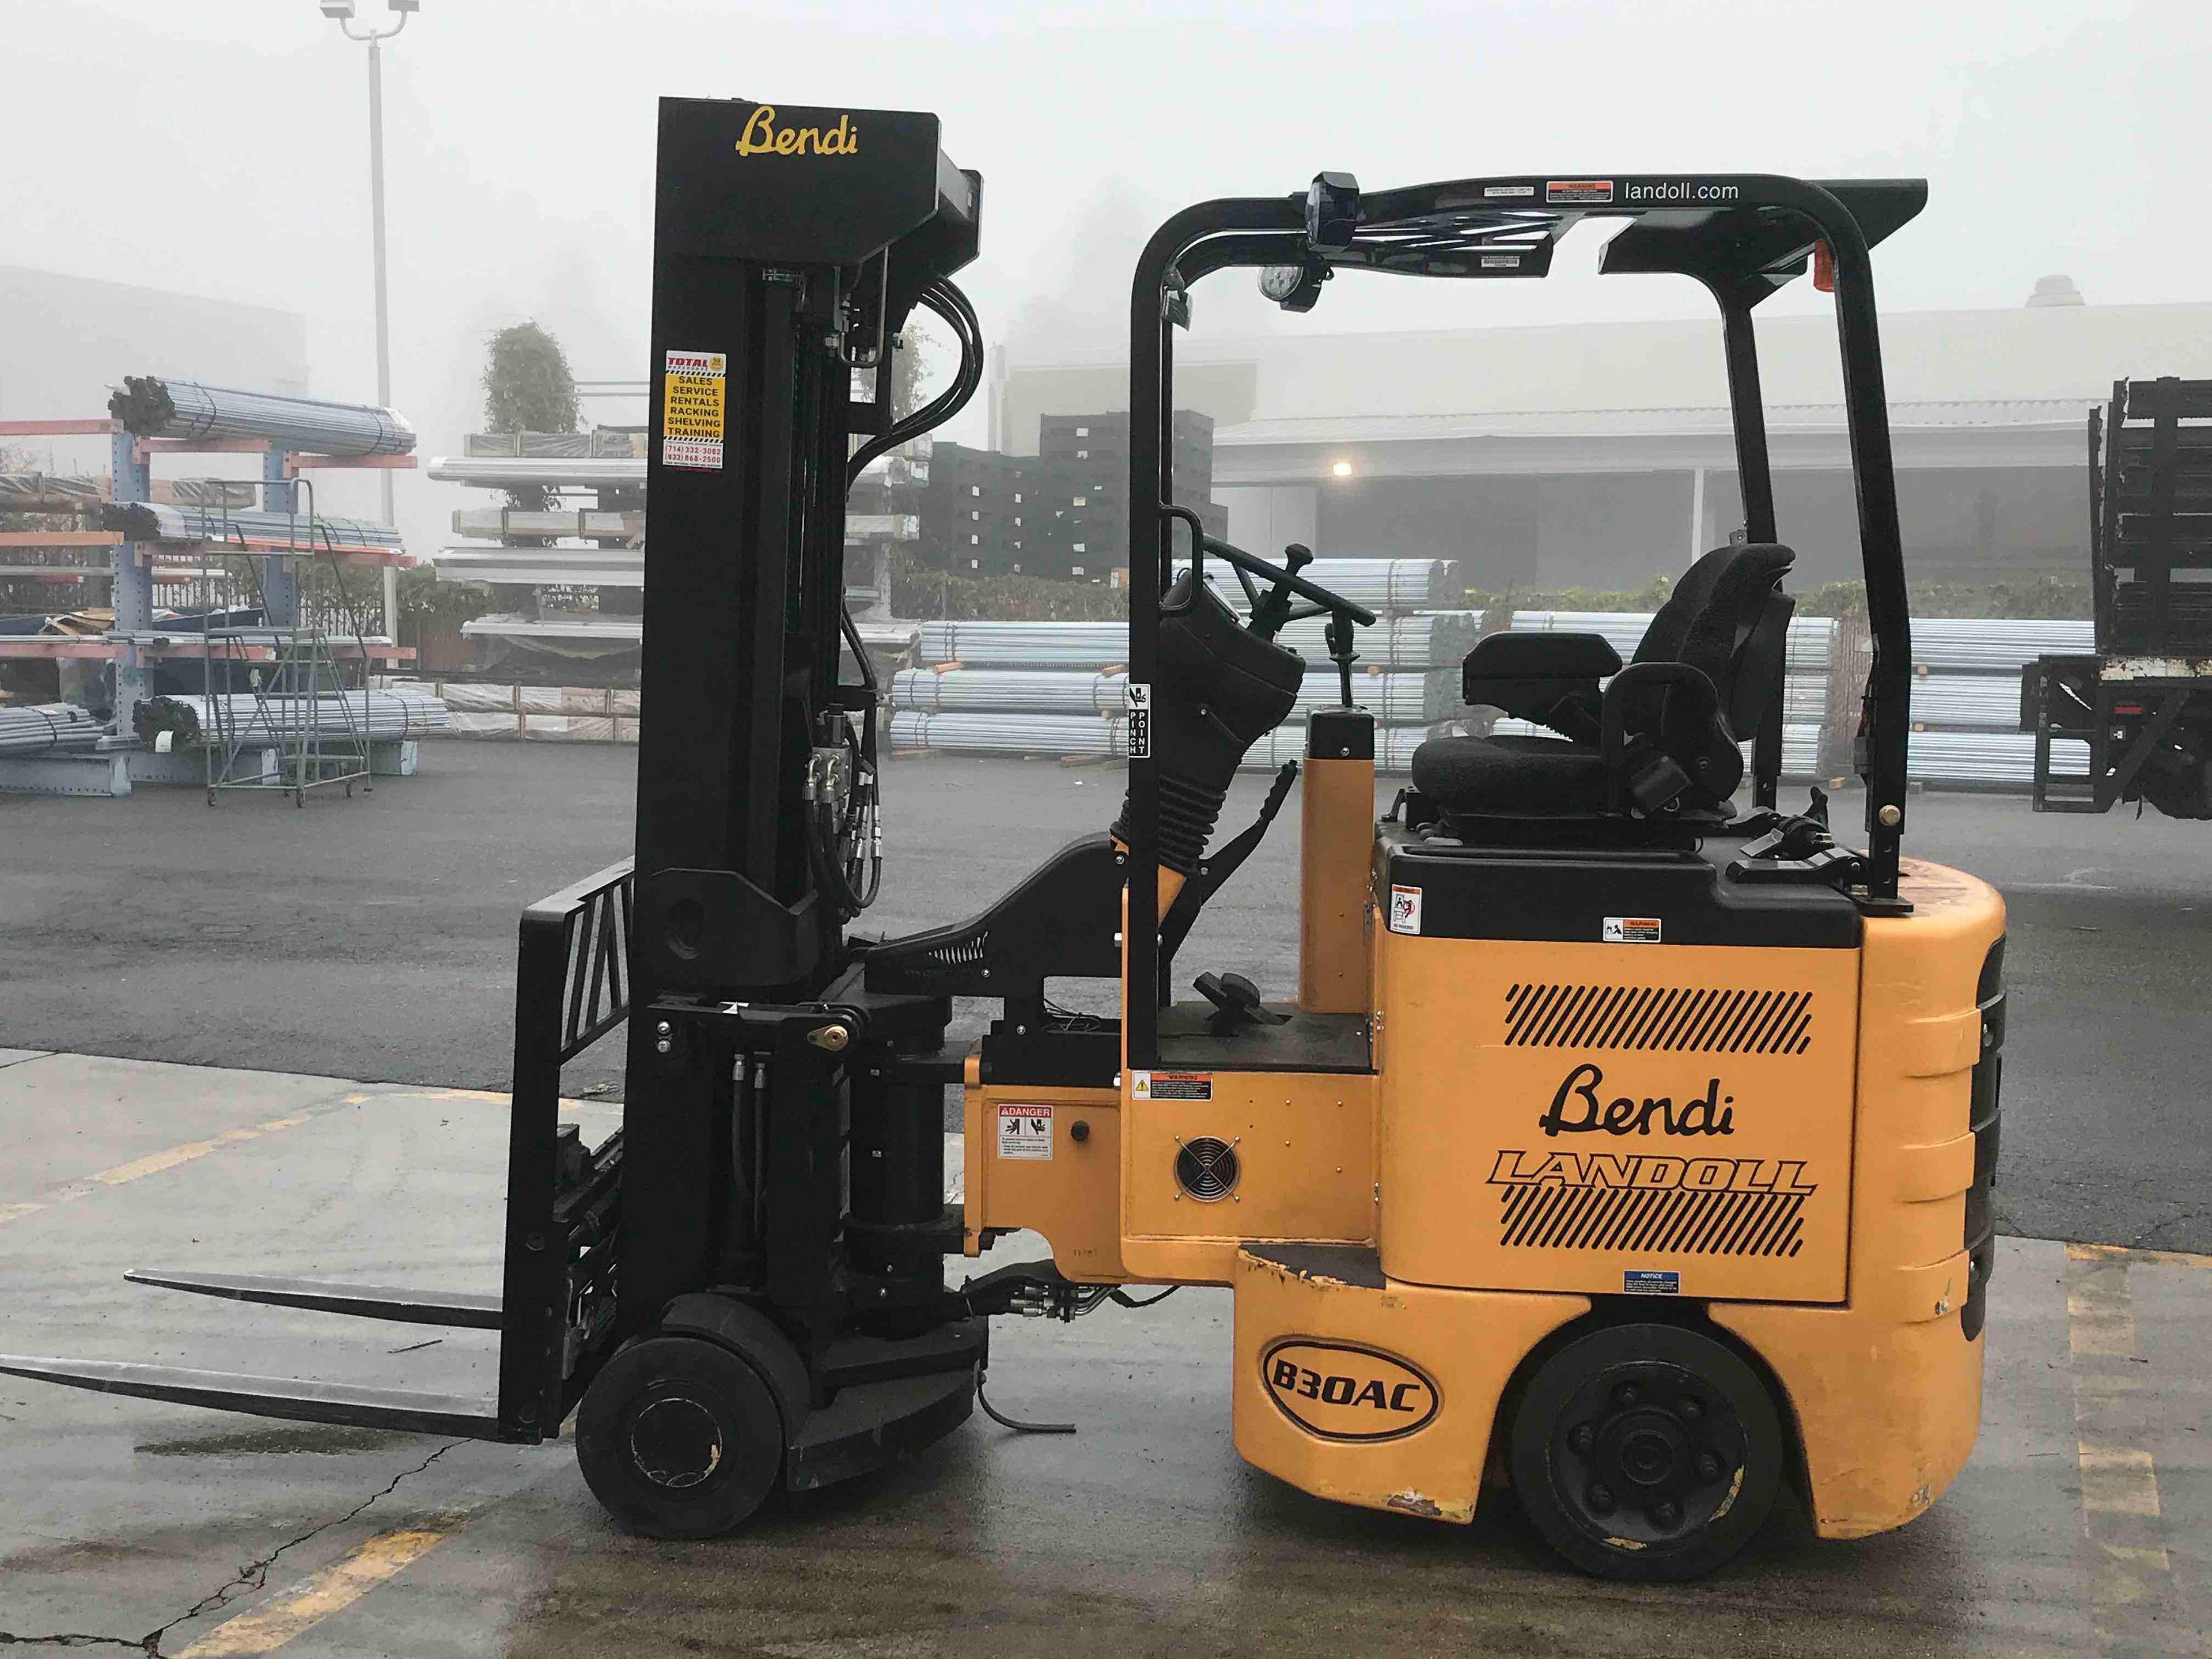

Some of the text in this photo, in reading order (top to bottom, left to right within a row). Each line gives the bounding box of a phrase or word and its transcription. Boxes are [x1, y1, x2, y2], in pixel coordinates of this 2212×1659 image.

[735, 105, 858, 156] Bendi
[1625, 182, 1738, 199] landoll.com
[668, 357, 708, 367] TOTAL
[679, 376, 713, 385] SALES
[673, 386, 718, 396] SERVICE
[671, 396, 719, 407] RENTALS
[671, 407, 719, 417] RACKING
[668, 417, 721, 427] SHELVING
[668, 427, 719, 438] TRAINING
[1539, 1063, 1734, 1137] Bendi
[1009, 1107, 1050, 1116] DANGER
[1486, 1150, 1819, 1196] LANDOLL
[1272, 1358, 1421, 1412] B30AC
